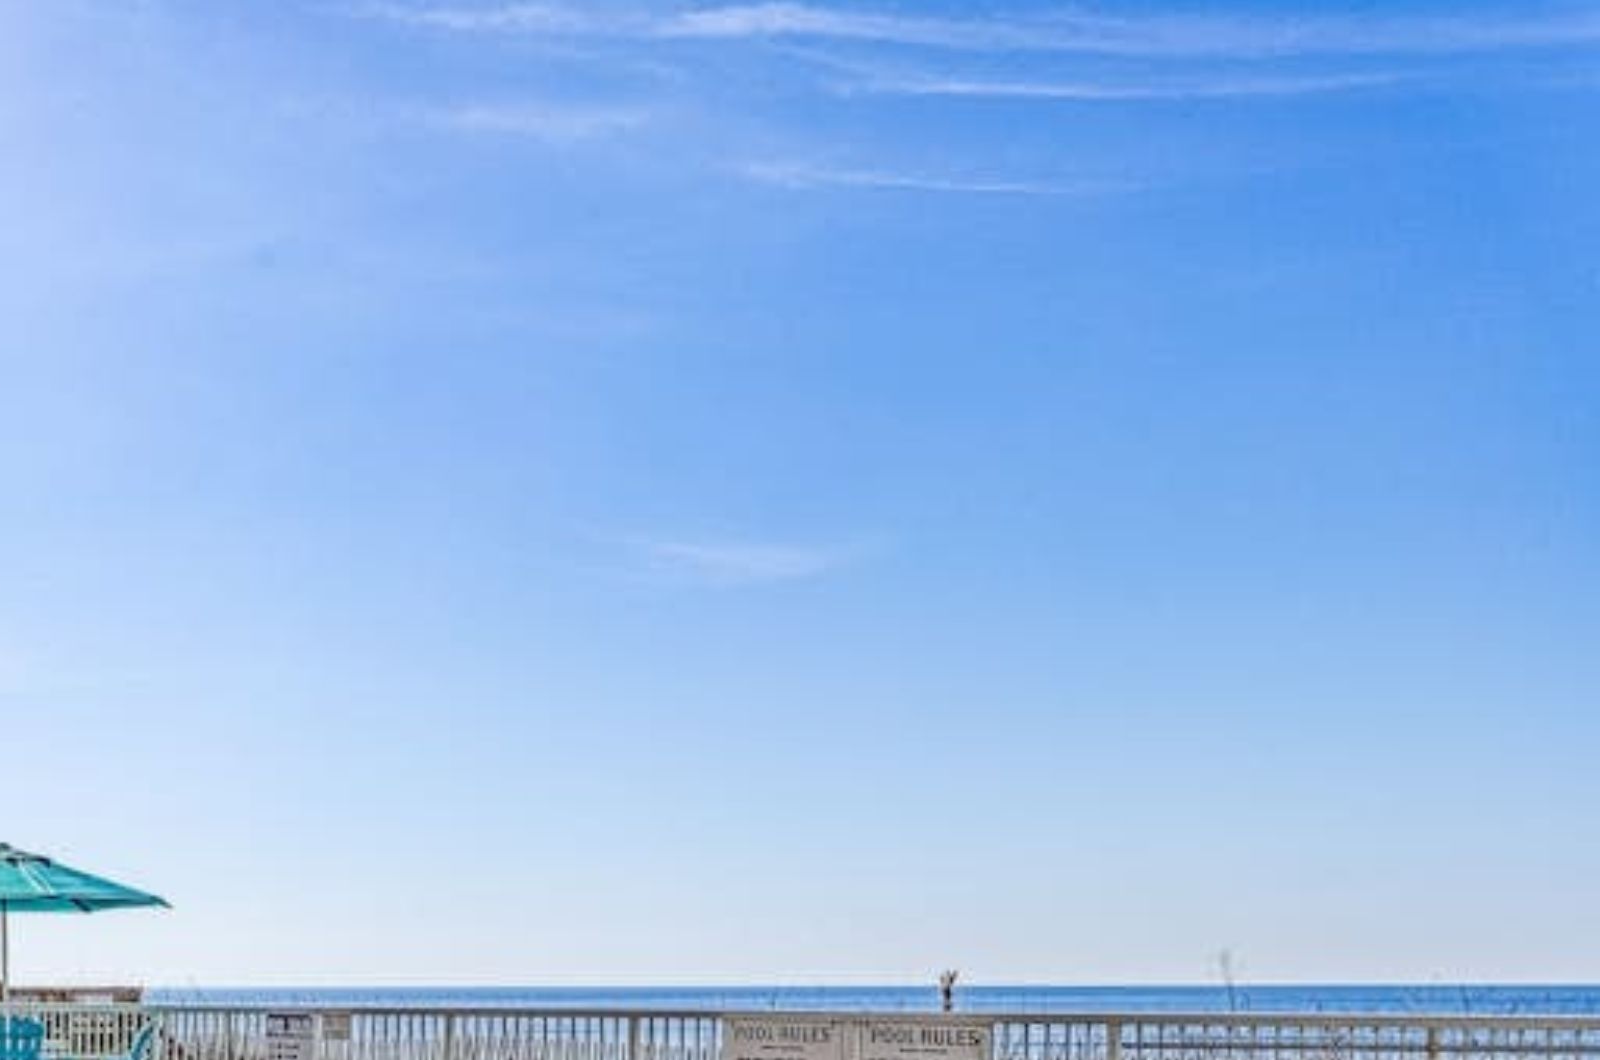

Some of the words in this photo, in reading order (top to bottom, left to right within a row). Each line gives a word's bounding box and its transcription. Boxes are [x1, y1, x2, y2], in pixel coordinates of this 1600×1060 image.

[734, 1026, 774, 1042] POOL
[782, 1027, 830, 1043] RULES
[871, 1028, 914, 1045] POOL
[921, 1029, 976, 1046] RULES
